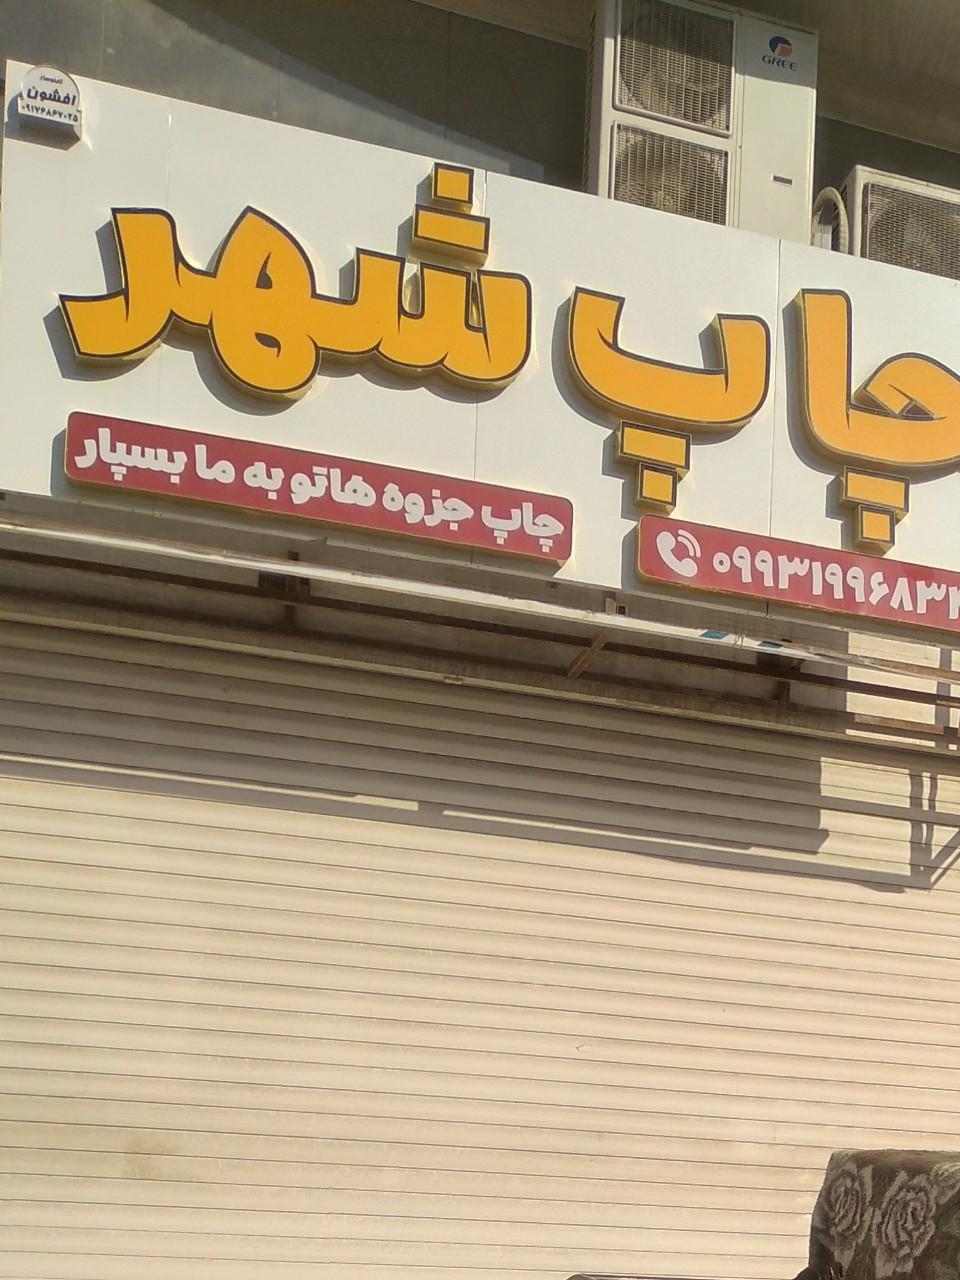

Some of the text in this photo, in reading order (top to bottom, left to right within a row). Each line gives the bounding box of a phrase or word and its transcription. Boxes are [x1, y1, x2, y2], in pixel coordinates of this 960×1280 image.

[762, 54, 799, 71] GREE
[58, 161, 533, 394] شهر
[73, 427, 188, 485] بسپار
[194, 444, 236, 484] ما
[243, 461, 285, 501] به
[382, 482, 474, 531] جزوه
[481, 502, 565, 553] چاپ
